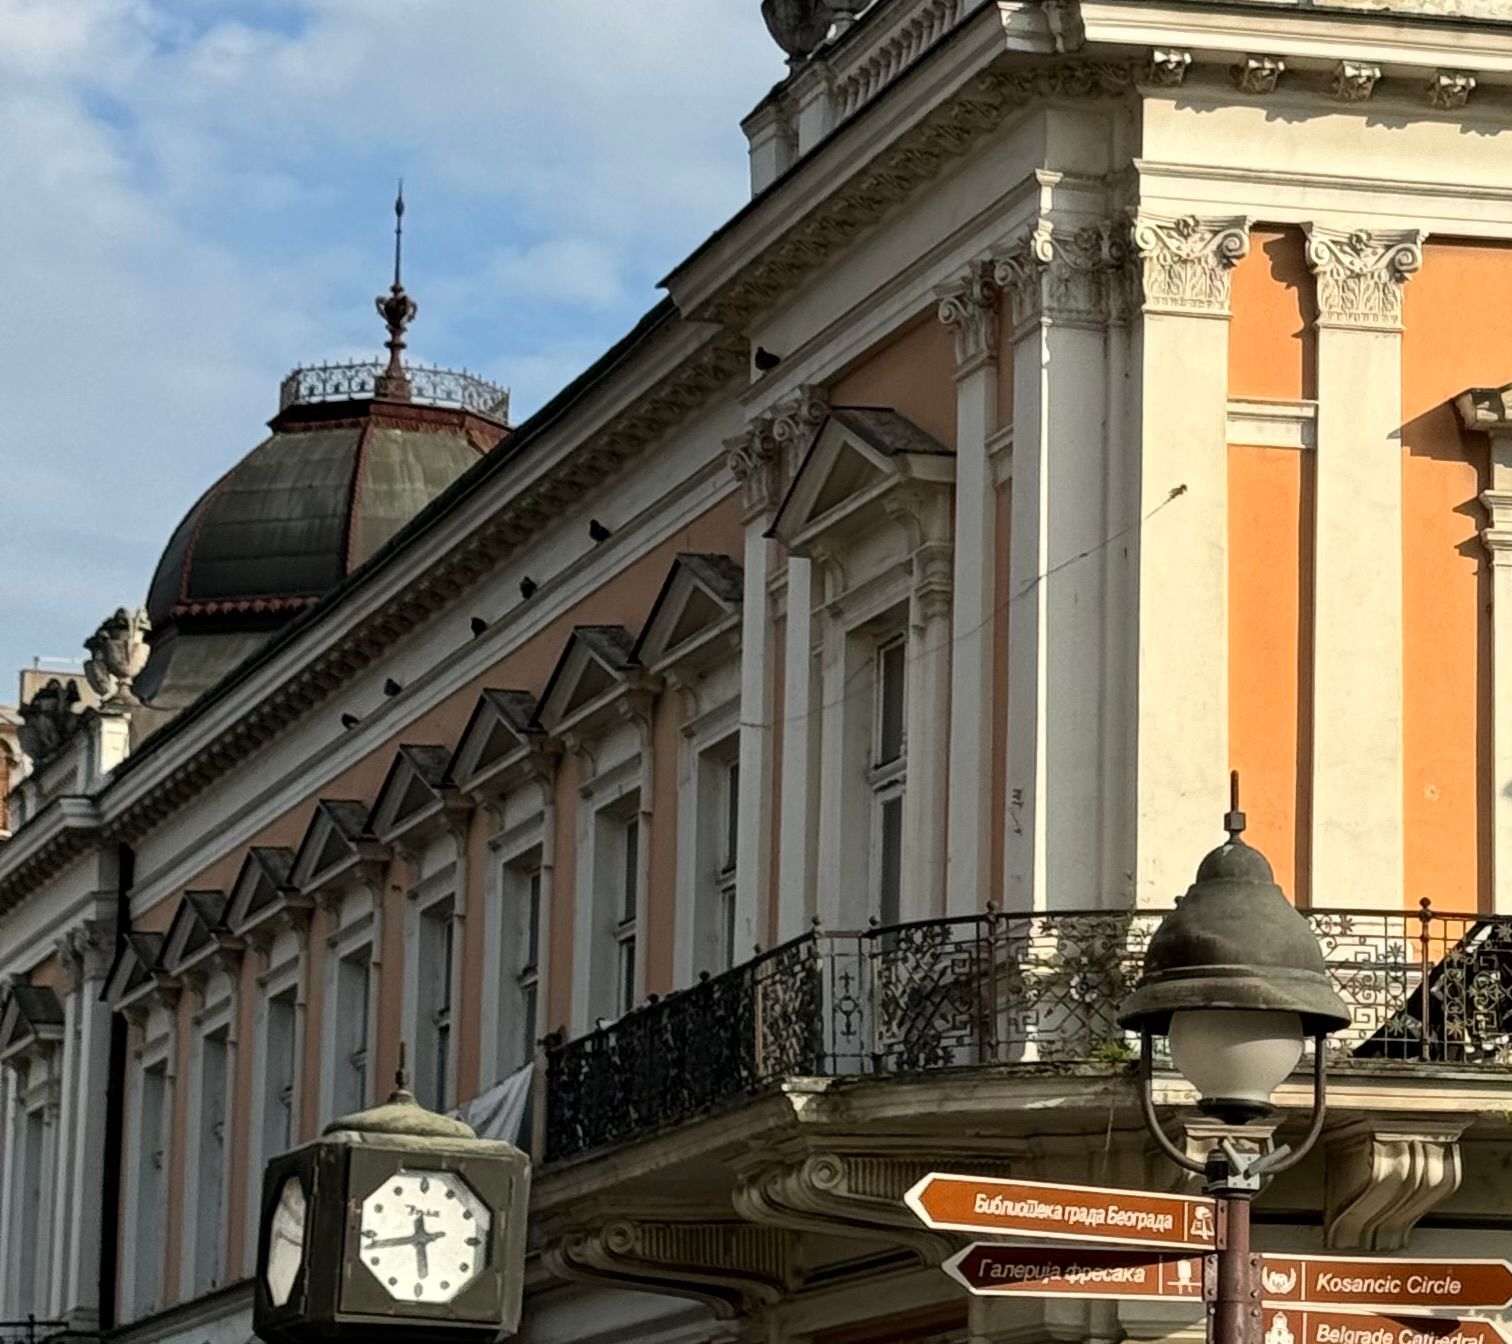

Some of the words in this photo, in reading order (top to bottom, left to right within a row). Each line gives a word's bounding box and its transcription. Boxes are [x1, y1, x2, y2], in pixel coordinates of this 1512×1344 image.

[974, 1193, 1061, 1221] Библиотека
[1064, 1204, 1105, 1227] града
[1107, 1205, 1173, 1233] Београда
[978, 1258, 1061, 1284] Галерија
[1064, 1261, 1146, 1284] фресака
[1316, 1272, 1401, 1294] Kosancic
[1406, 1274, 1462, 1294] Circle
